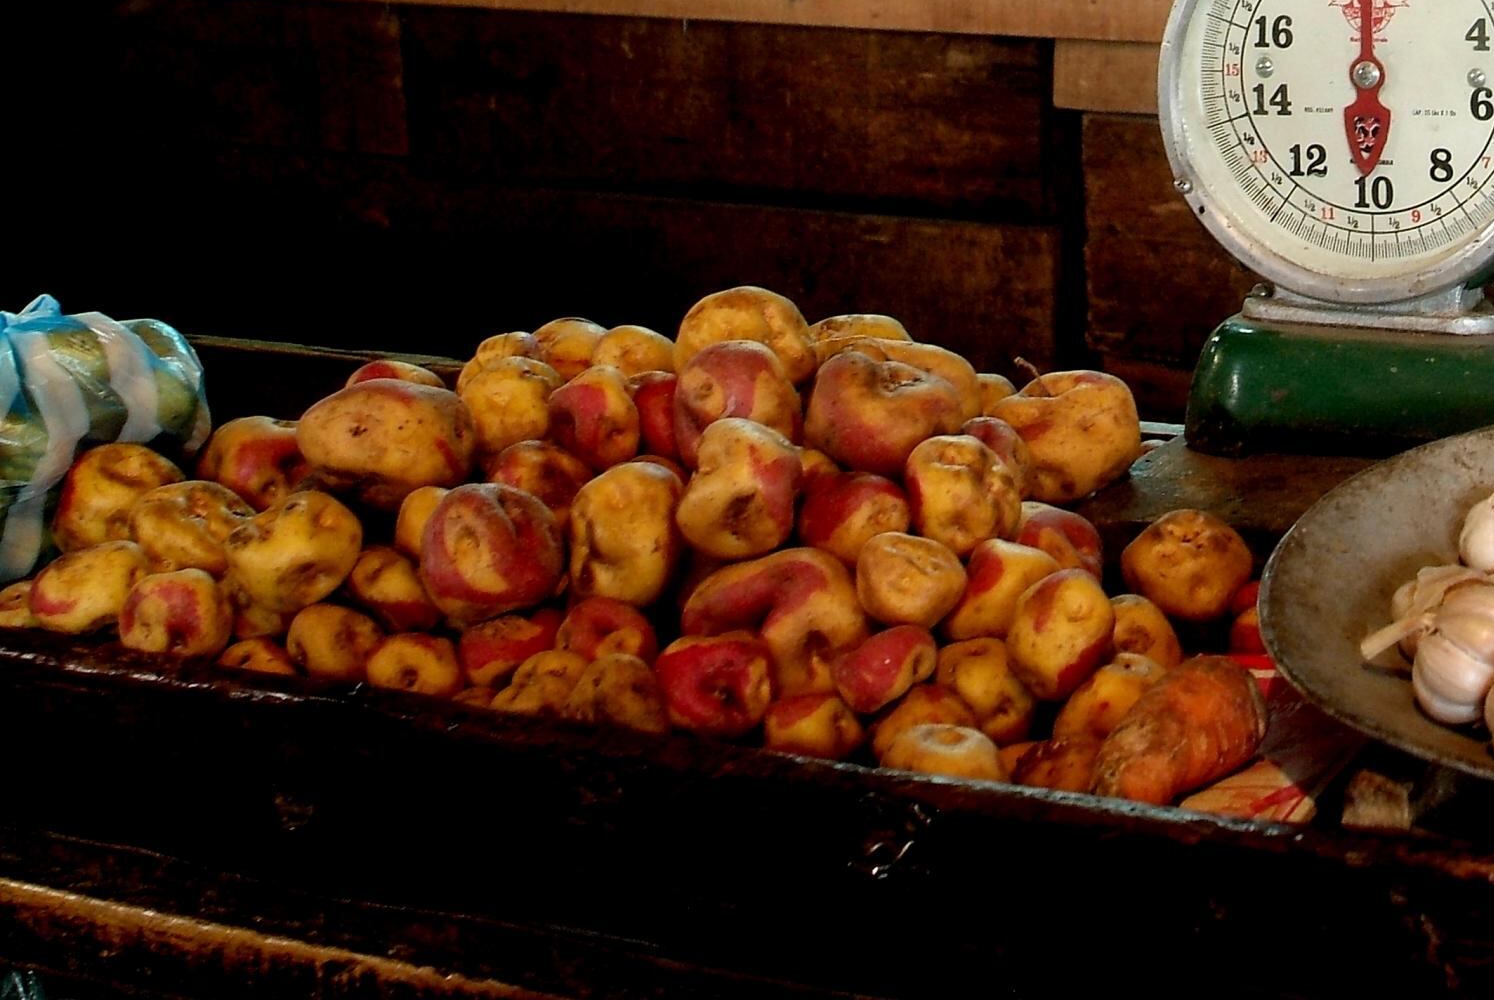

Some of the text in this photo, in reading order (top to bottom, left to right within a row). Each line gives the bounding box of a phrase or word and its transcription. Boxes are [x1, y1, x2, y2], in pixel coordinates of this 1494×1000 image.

[1255, 15, 1293, 48] 16
[1465, 18, 1490, 51] 4
[1225, 64, 1239, 75] 15
[1253, 84, 1292, 115] 14
[1470, 87, 1494, 121] 6
[1252, 151, 1267, 164] 13
[1290, 144, 1327, 176] 12
[1430, 148, 1453, 182] 8
[1482, 157, 1491, 168] 7
[1354, 176, 1393, 209] 10
[1322, 208, 1334, 219] 11
[1412, 210, 1420, 222] 9
